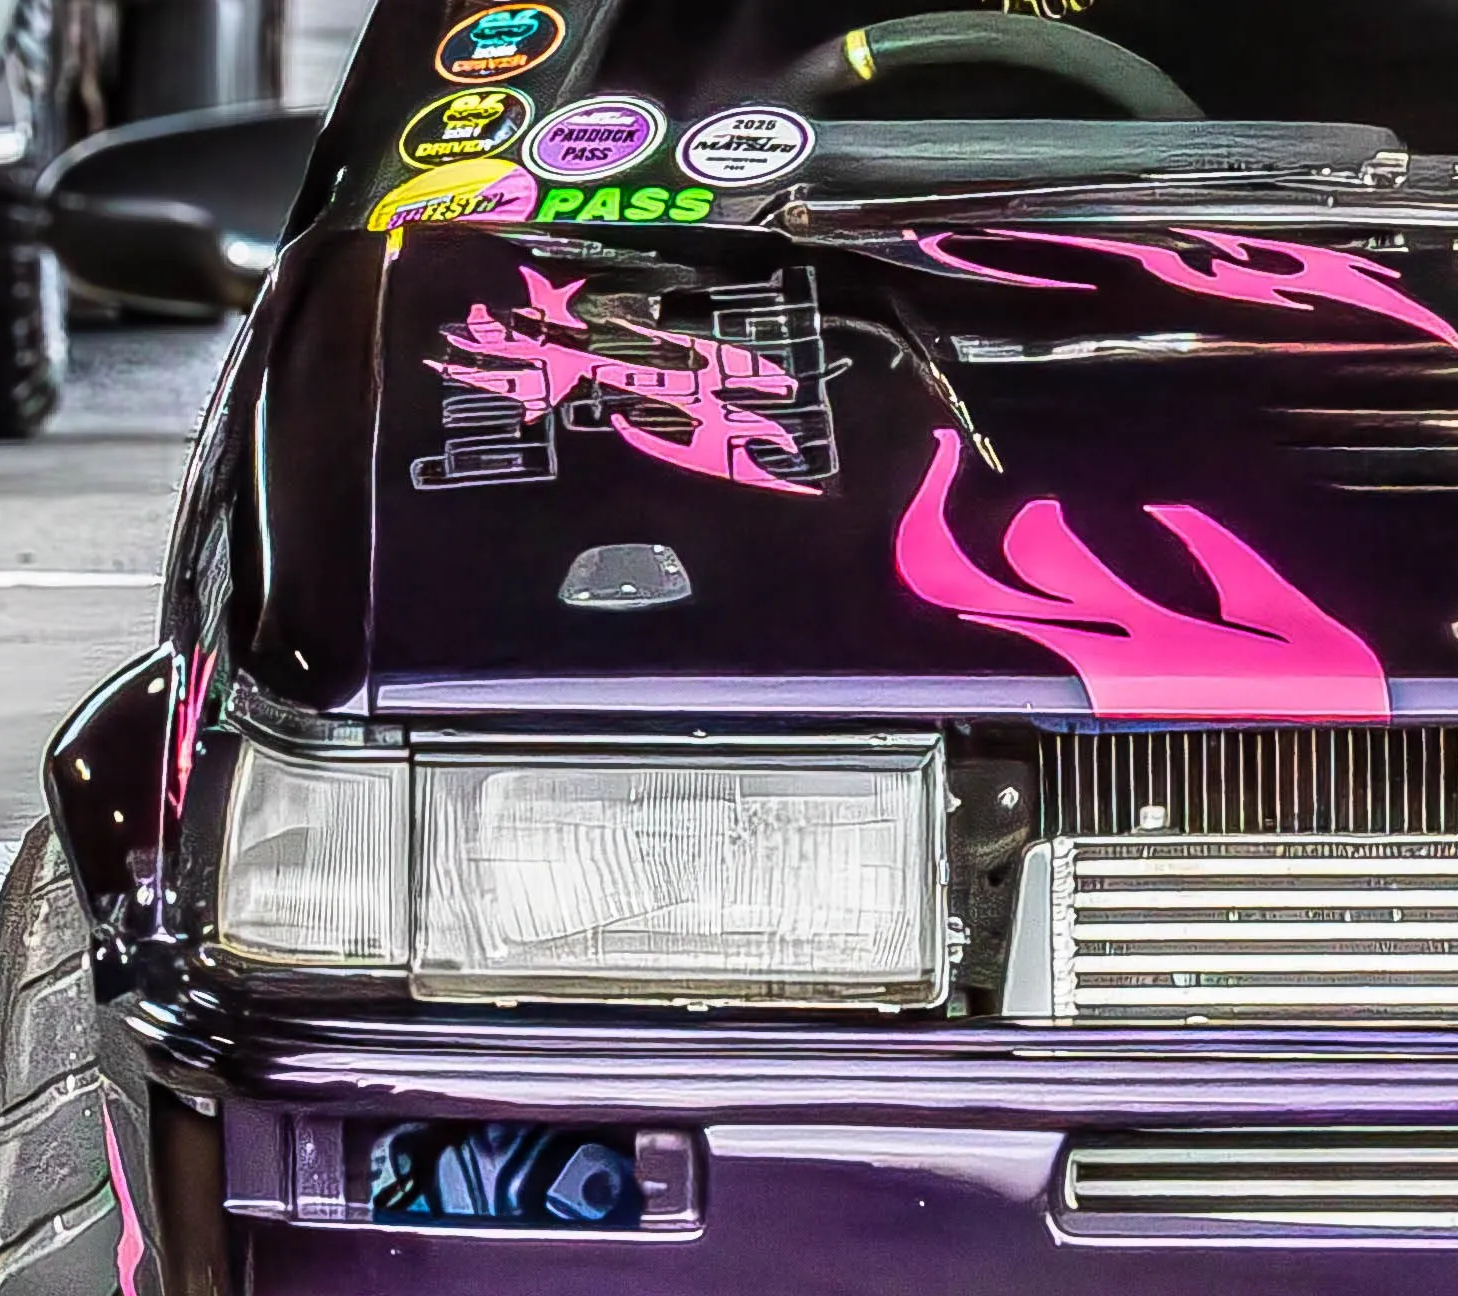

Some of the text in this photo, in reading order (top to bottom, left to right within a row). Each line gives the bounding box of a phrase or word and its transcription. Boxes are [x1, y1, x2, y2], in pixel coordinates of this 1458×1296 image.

[548, 125, 641, 144] PADDOCK
[561, 146, 613, 162] PASS
[536, 185, 715, 222] PASS
